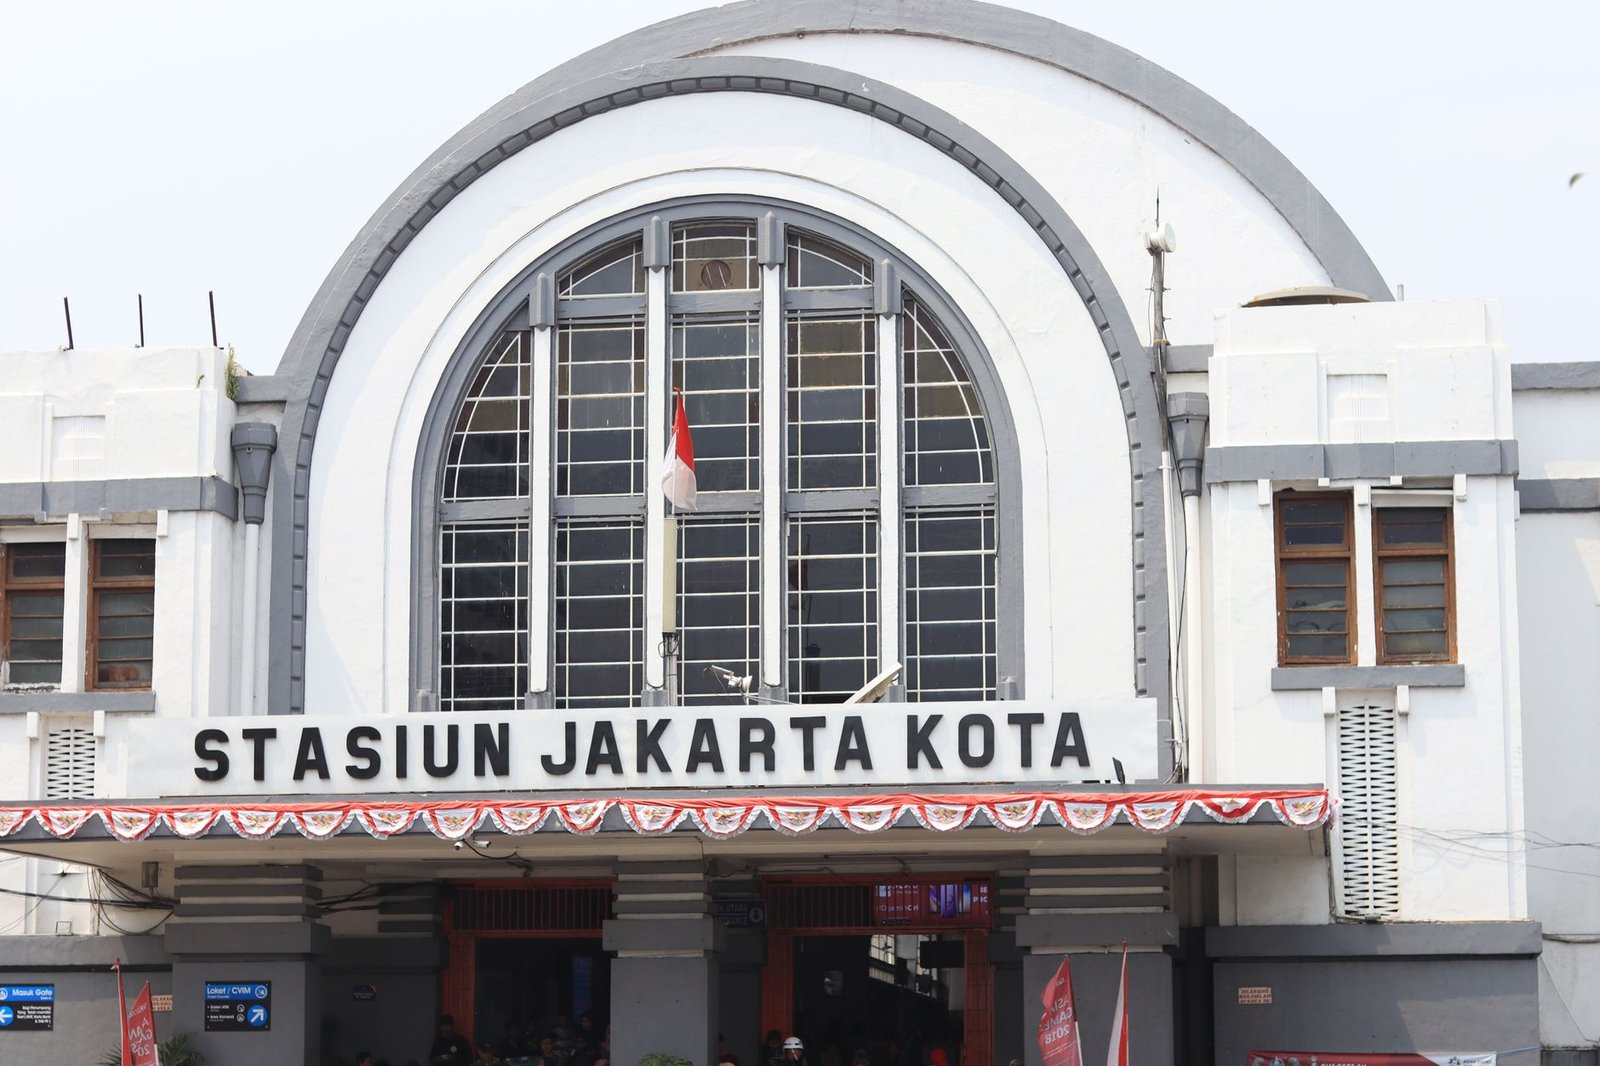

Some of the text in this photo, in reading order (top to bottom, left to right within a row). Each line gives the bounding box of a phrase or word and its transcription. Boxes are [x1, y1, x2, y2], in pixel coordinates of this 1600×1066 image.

[194, 711, 1091, 783] STASIUN JAKARTA KOTA
[207, 986, 226, 995] Loket
